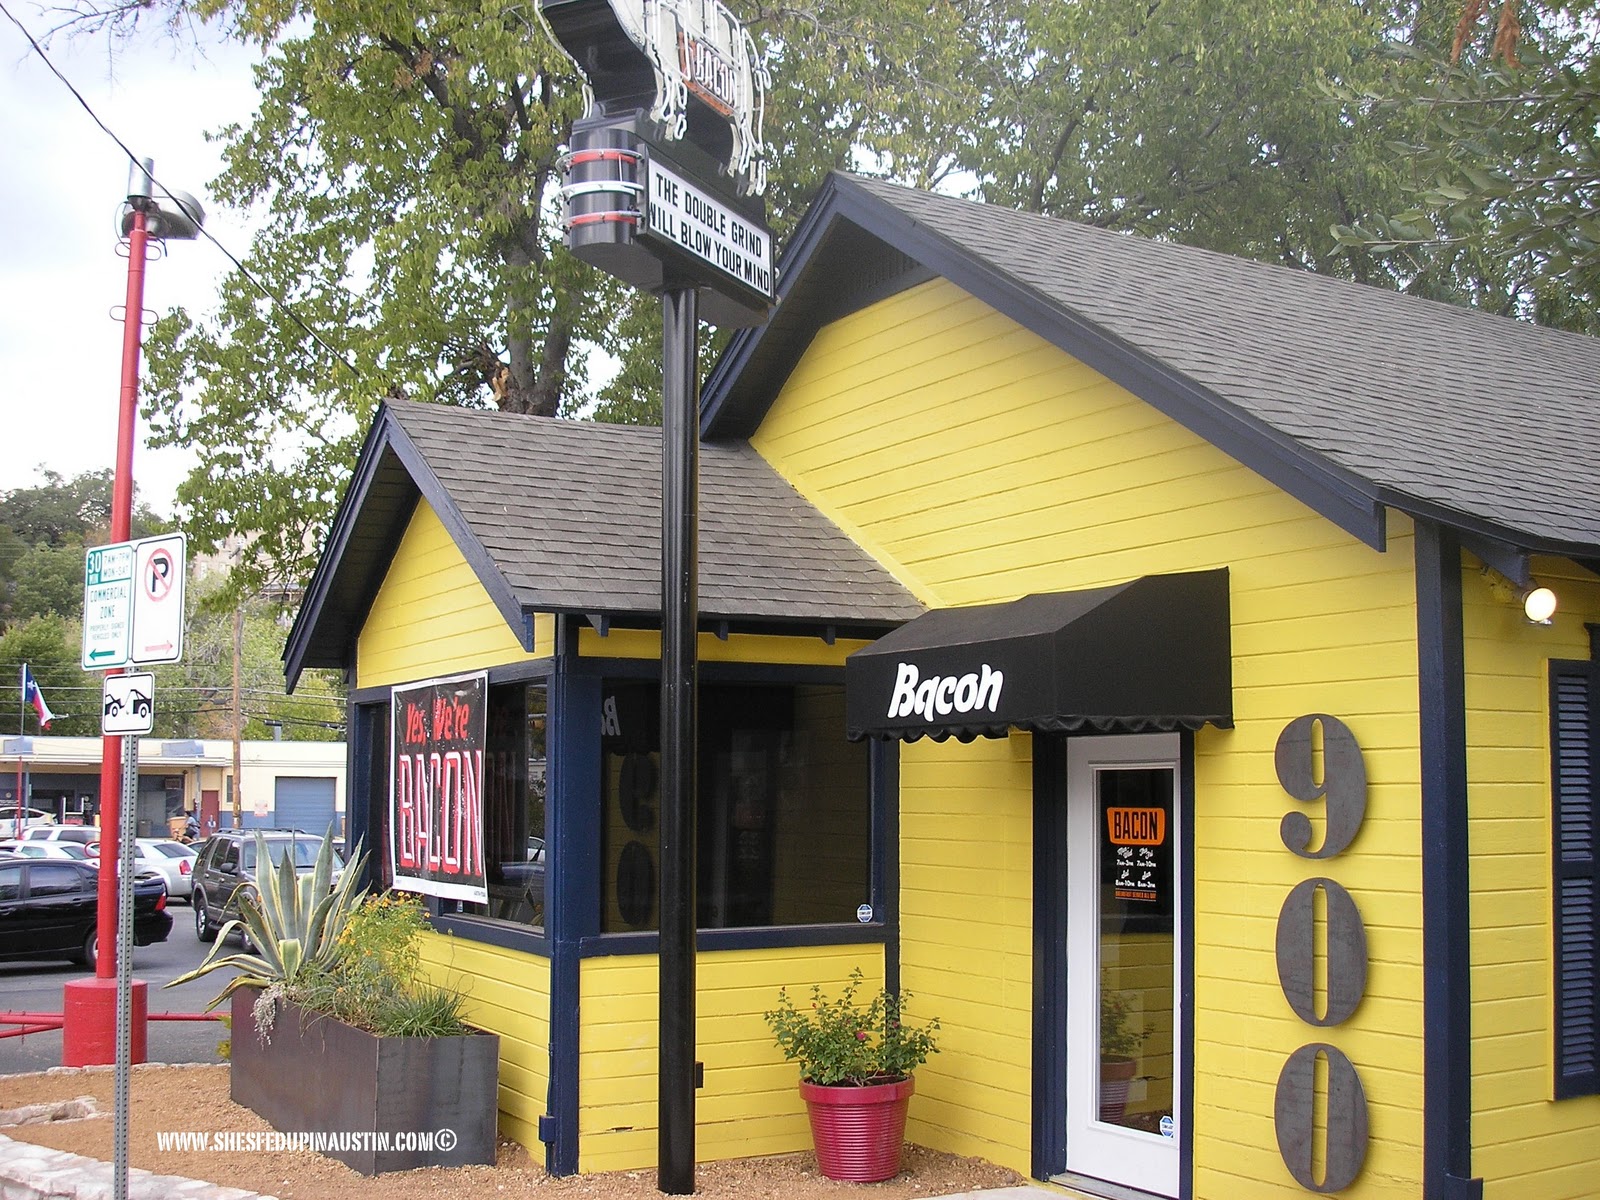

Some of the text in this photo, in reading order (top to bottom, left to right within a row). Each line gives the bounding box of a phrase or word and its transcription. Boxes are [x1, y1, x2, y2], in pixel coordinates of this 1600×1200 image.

[656, 172, 762, 259] THE DOUBLE GRIND
[681, 220, 712, 259] BLOW
[714, 240, 742, 277] YOUR
[744, 258, 770, 293] MIND
[88, 551, 102, 574] 30
[90, 586, 127, 603] COMMERCIAL
[100, 605, 116, 619] ZONE
[887, 662, 1004, 722] Bacon
[405, 696, 470, 746] Yes, We're
[400, 750, 483, 877] BACON
[1114, 811, 1158, 840] BACON
[1274, 713, 1368, 1194] 900
